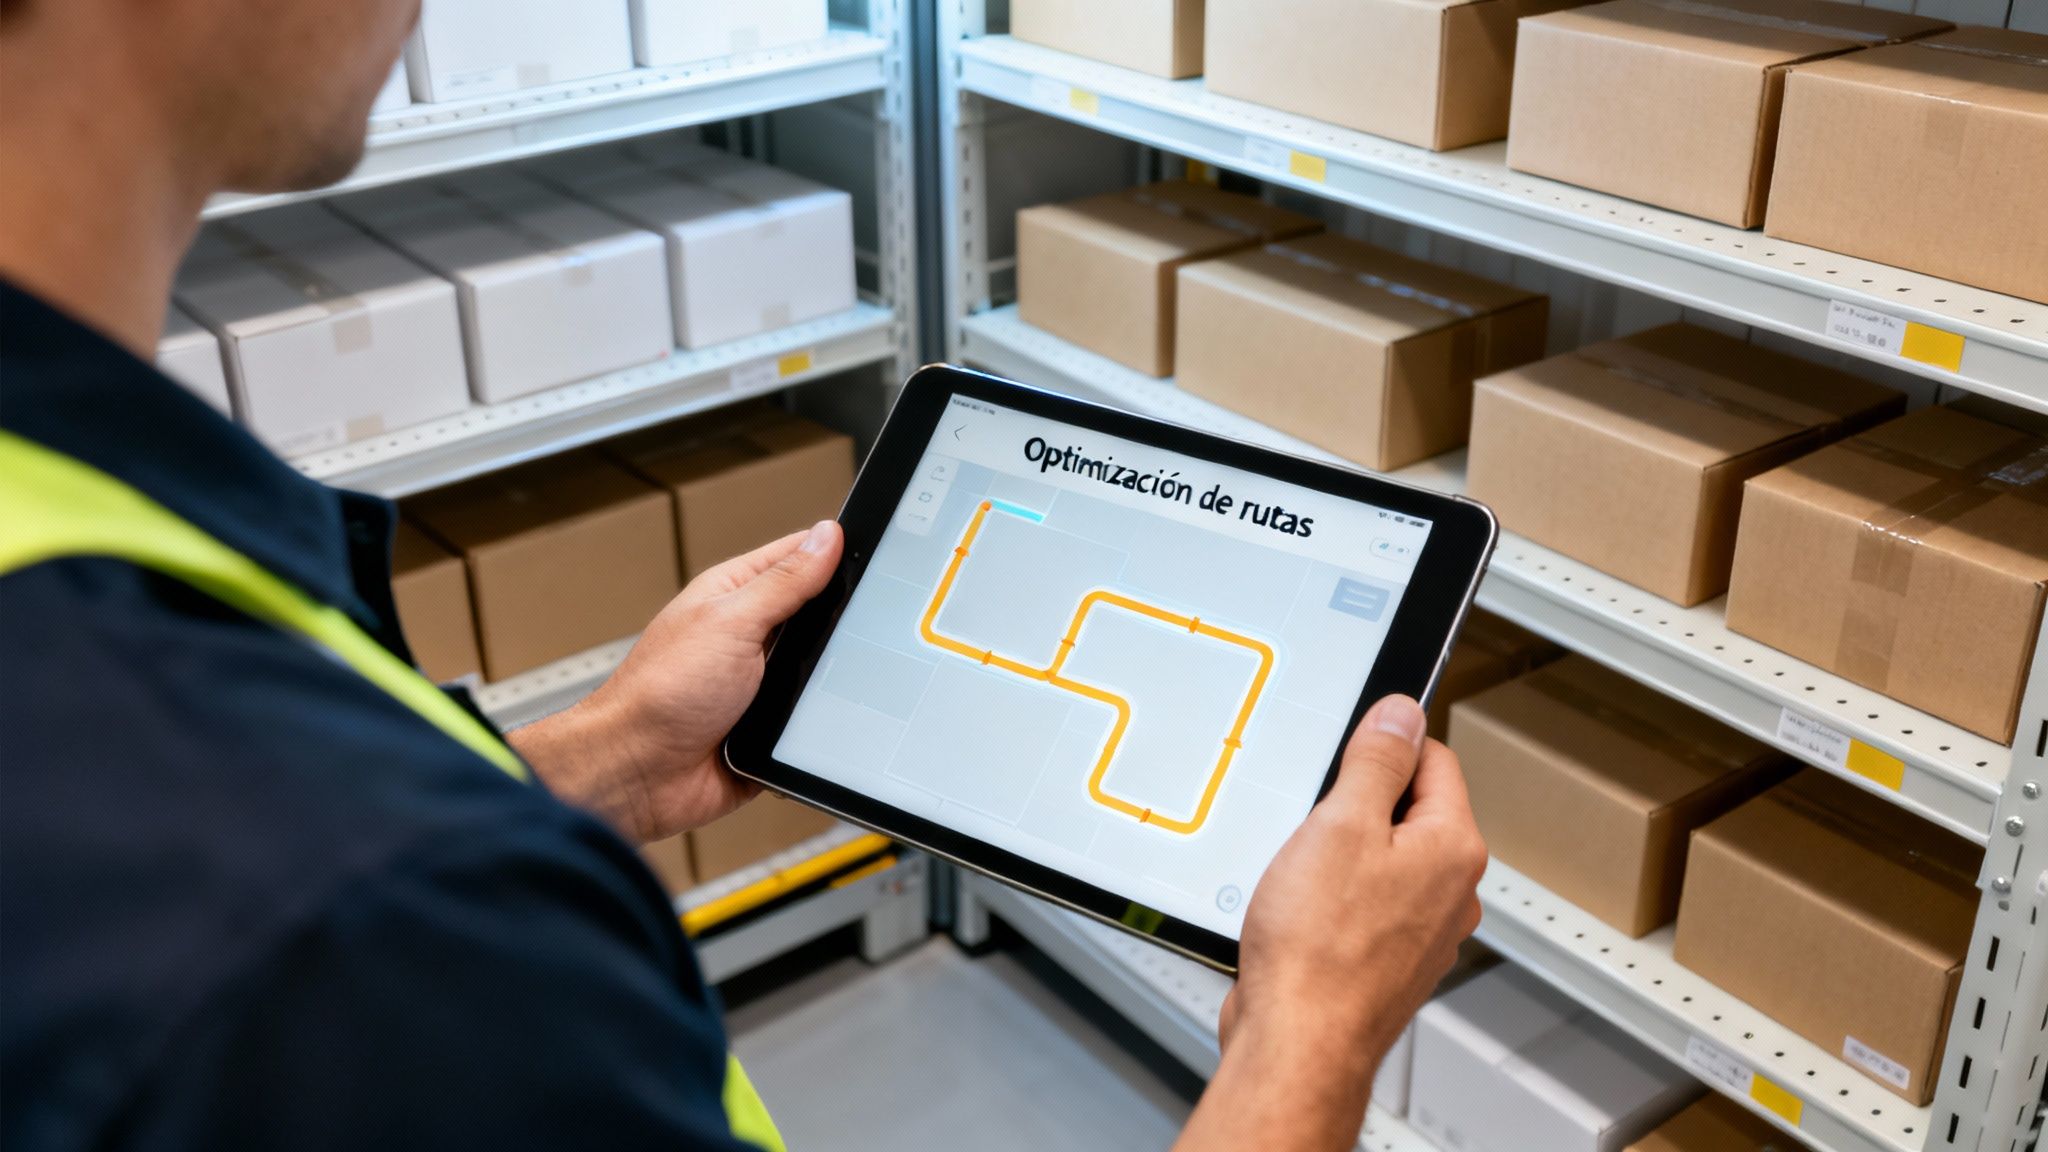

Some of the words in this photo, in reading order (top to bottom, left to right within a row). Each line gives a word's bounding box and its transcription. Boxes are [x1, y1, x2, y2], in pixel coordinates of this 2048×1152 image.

[1024, 437, 1193, 505] Optimización
[1199, 484, 1233, 515] de
[1239, 500, 1314, 538] rutas
